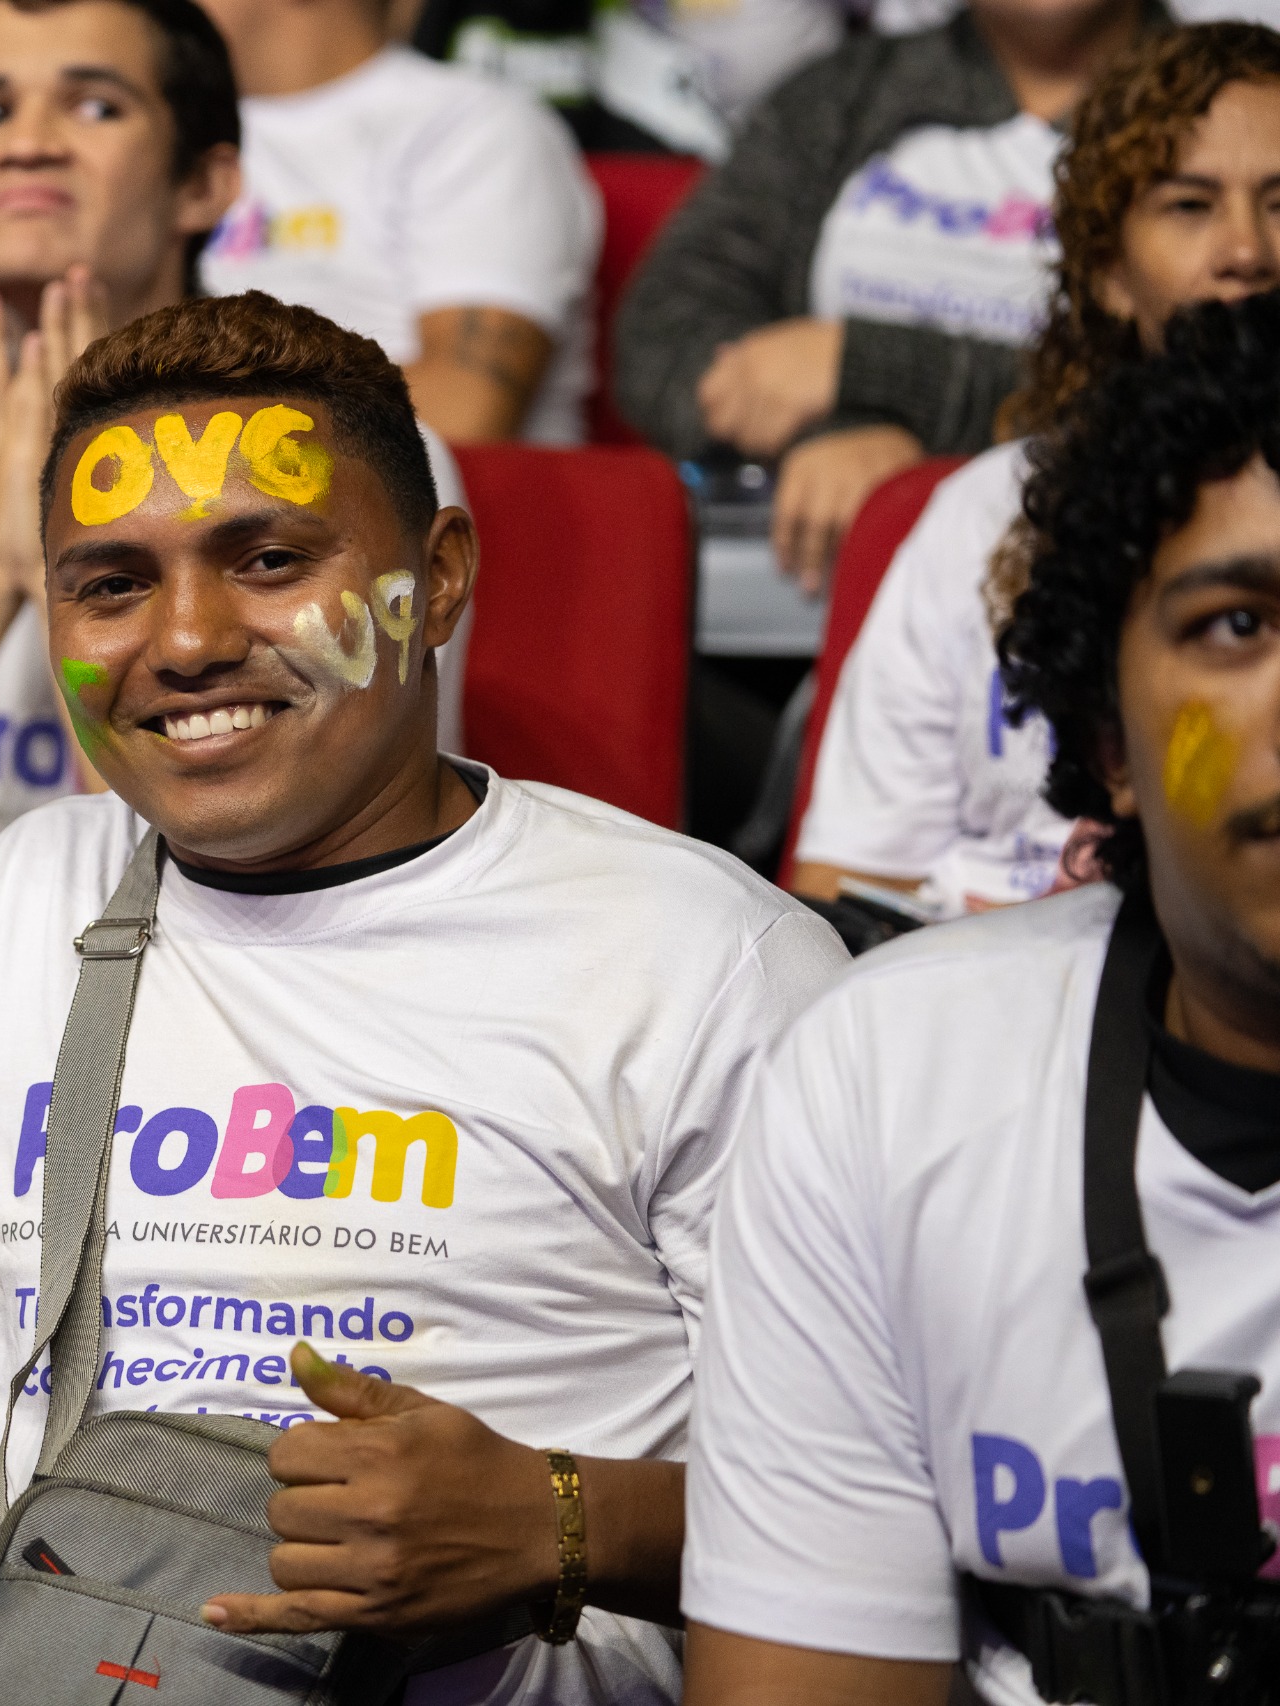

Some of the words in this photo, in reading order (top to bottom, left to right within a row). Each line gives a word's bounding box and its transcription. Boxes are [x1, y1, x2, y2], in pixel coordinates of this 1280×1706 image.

[132, 1220, 322, 1247] UNIVERSITÁRIO
[333, 1227, 376, 1249] DO
[389, 1232, 449, 1258] BEM
